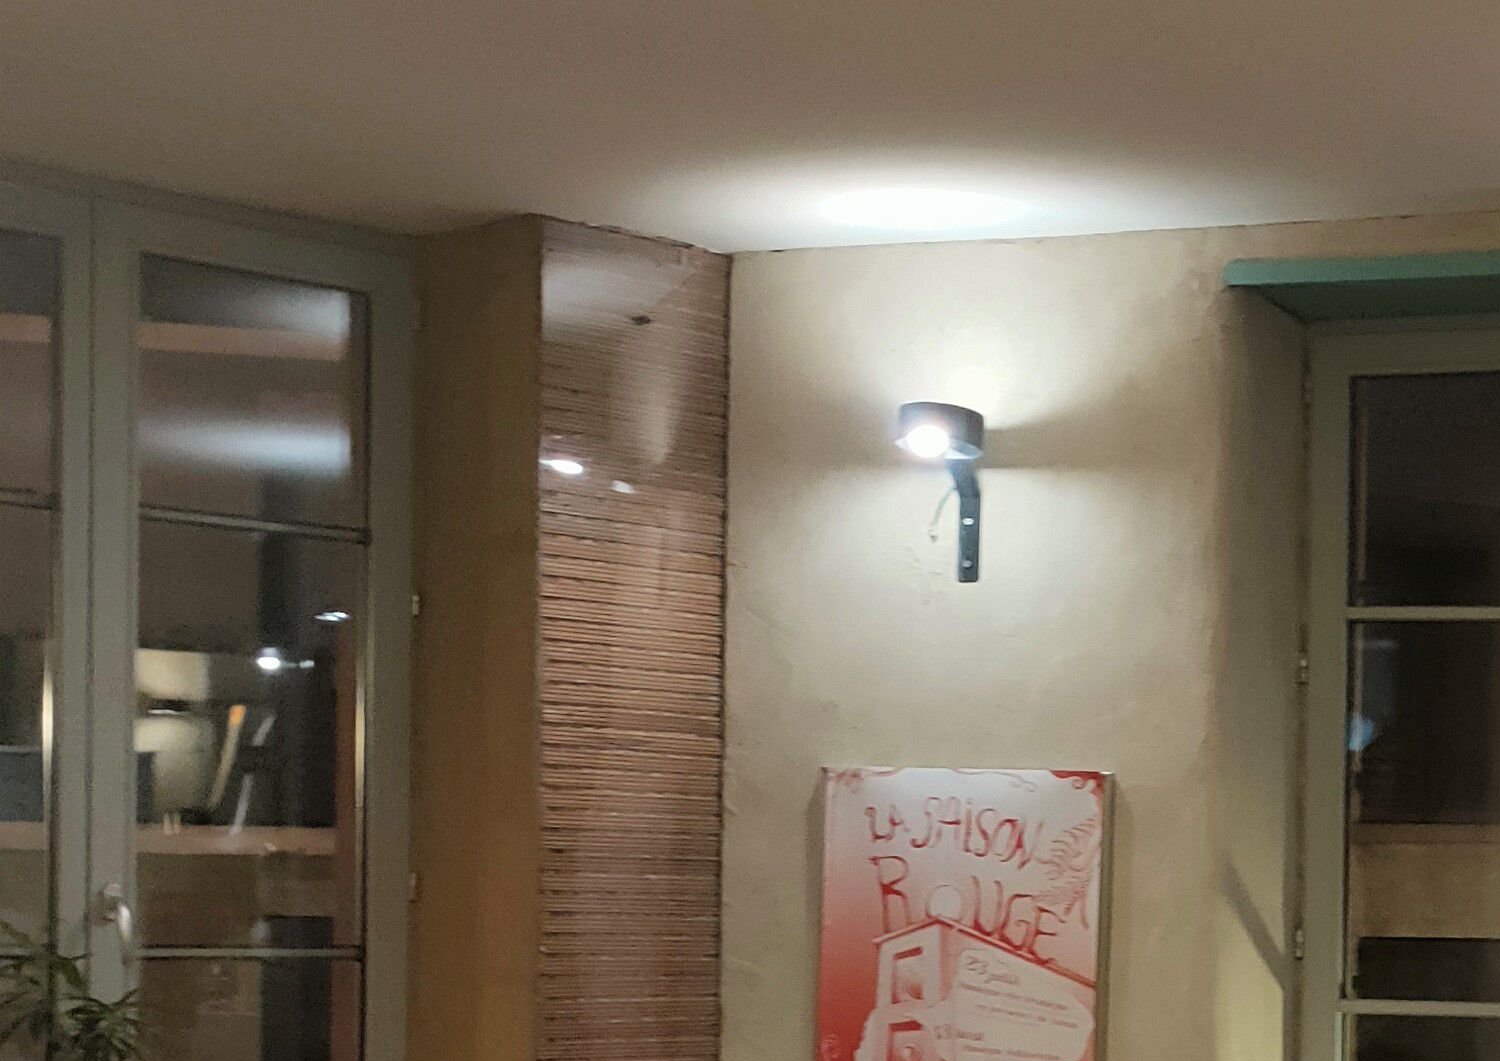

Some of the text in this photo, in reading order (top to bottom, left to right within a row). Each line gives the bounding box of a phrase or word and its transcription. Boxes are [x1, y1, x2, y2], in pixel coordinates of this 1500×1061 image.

[865, 796, 1043, 869] LA SAISON
[868, 855, 1066, 964] ROUGE
